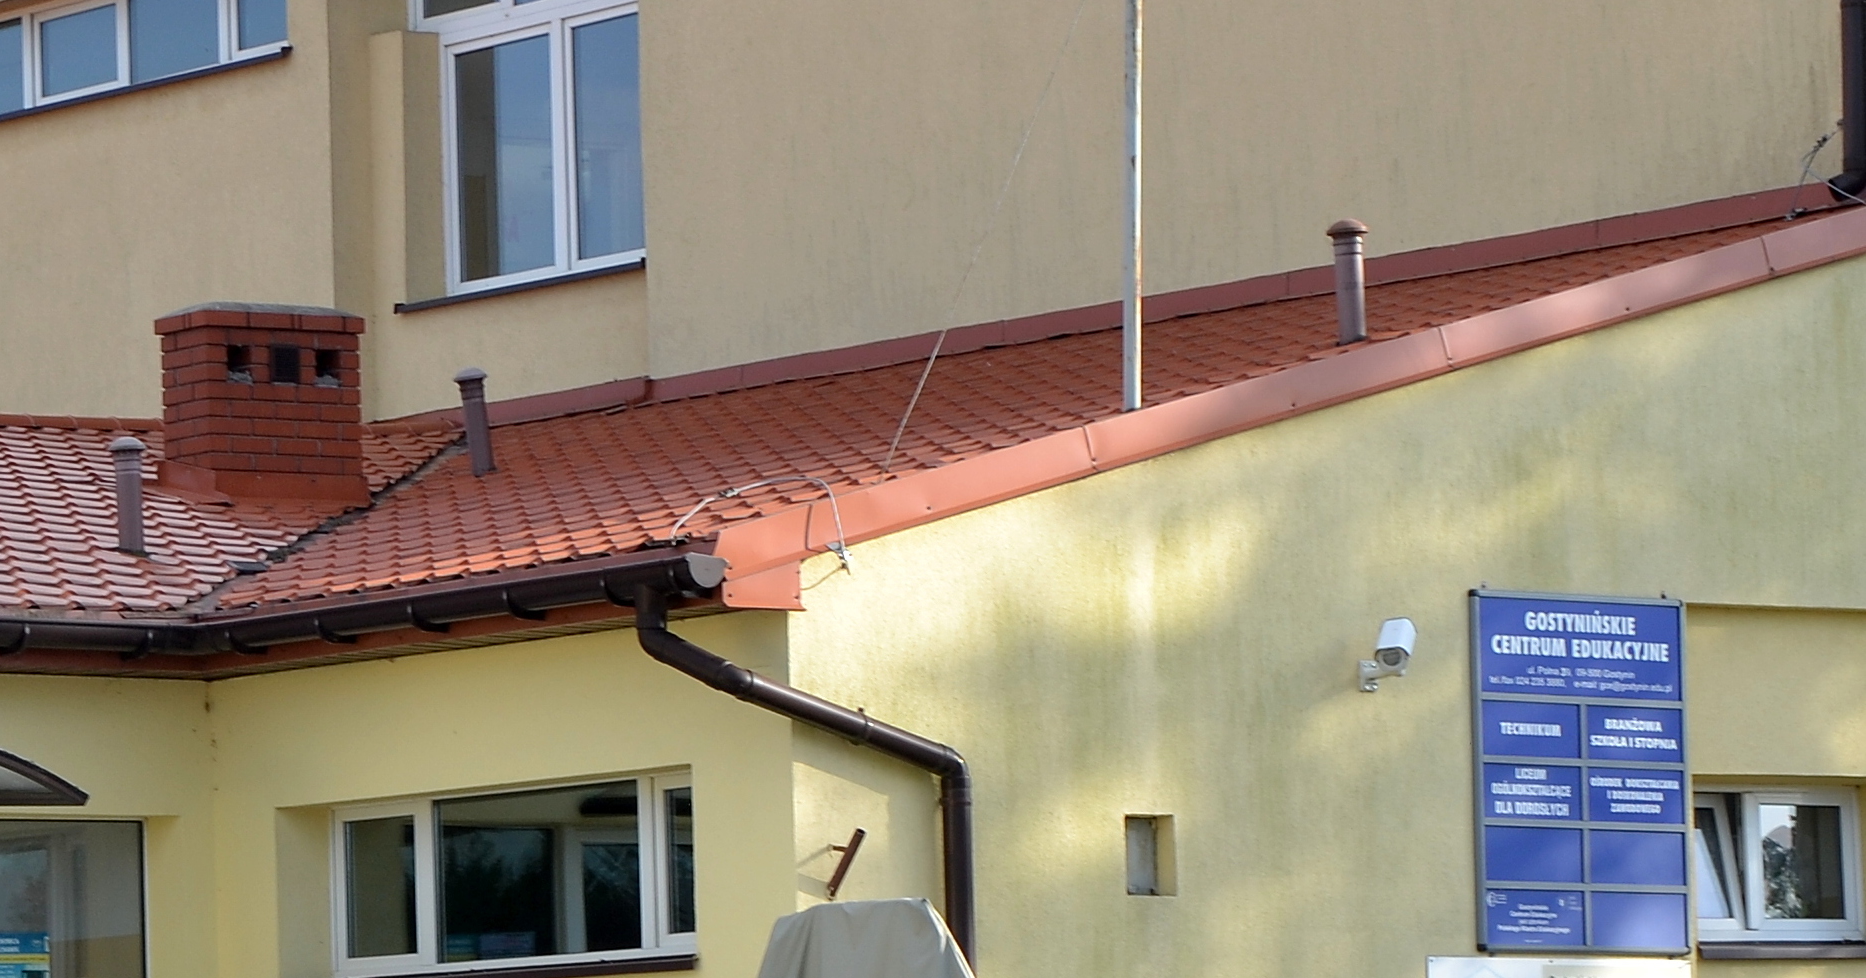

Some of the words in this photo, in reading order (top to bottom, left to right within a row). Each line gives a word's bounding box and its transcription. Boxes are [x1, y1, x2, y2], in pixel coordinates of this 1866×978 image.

[1524, 610, 1636, 635] GOSTYNIŃSKIE
[1491, 634, 1567, 657] CENTRUM
[1571, 638, 1670, 662] EDUKACYJNE
[1499, 721, 1562, 737] TECHNIKUM
[1603, 716, 1663, 732] BRANŻOWA
[1589, 735, 1628, 748] SZKOŁA
[1634, 736, 1678, 750] STOPNIA
[1514, 767, 1548, 780] LICEUM
[1494, 800, 1514, 814] DLA
[1515, 801, 1570, 816] DOROSŁYCH
